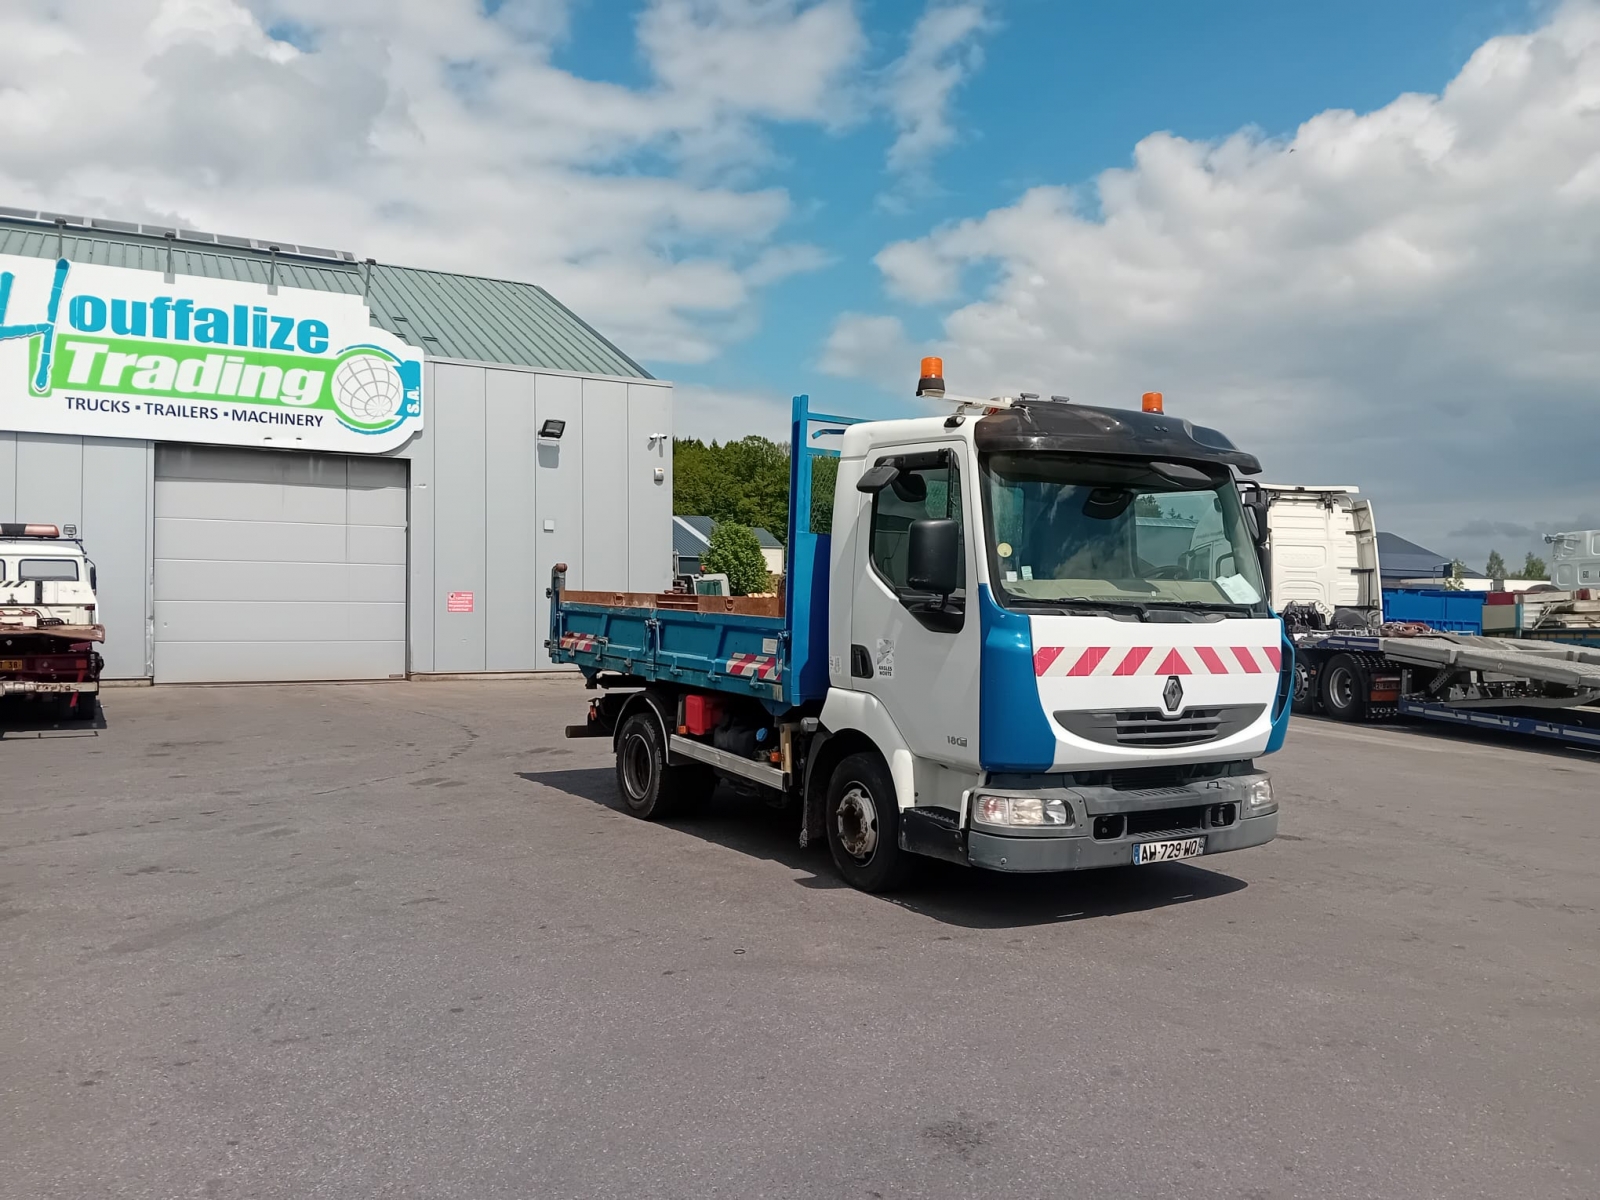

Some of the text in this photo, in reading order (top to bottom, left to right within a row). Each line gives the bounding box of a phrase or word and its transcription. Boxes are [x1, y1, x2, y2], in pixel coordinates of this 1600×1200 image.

[64, 341, 326, 406] Trading
[64, 397, 324, 428] TRUCKS TRAILERS MACHINERY
[406, 386, 420, 414] S.A.
